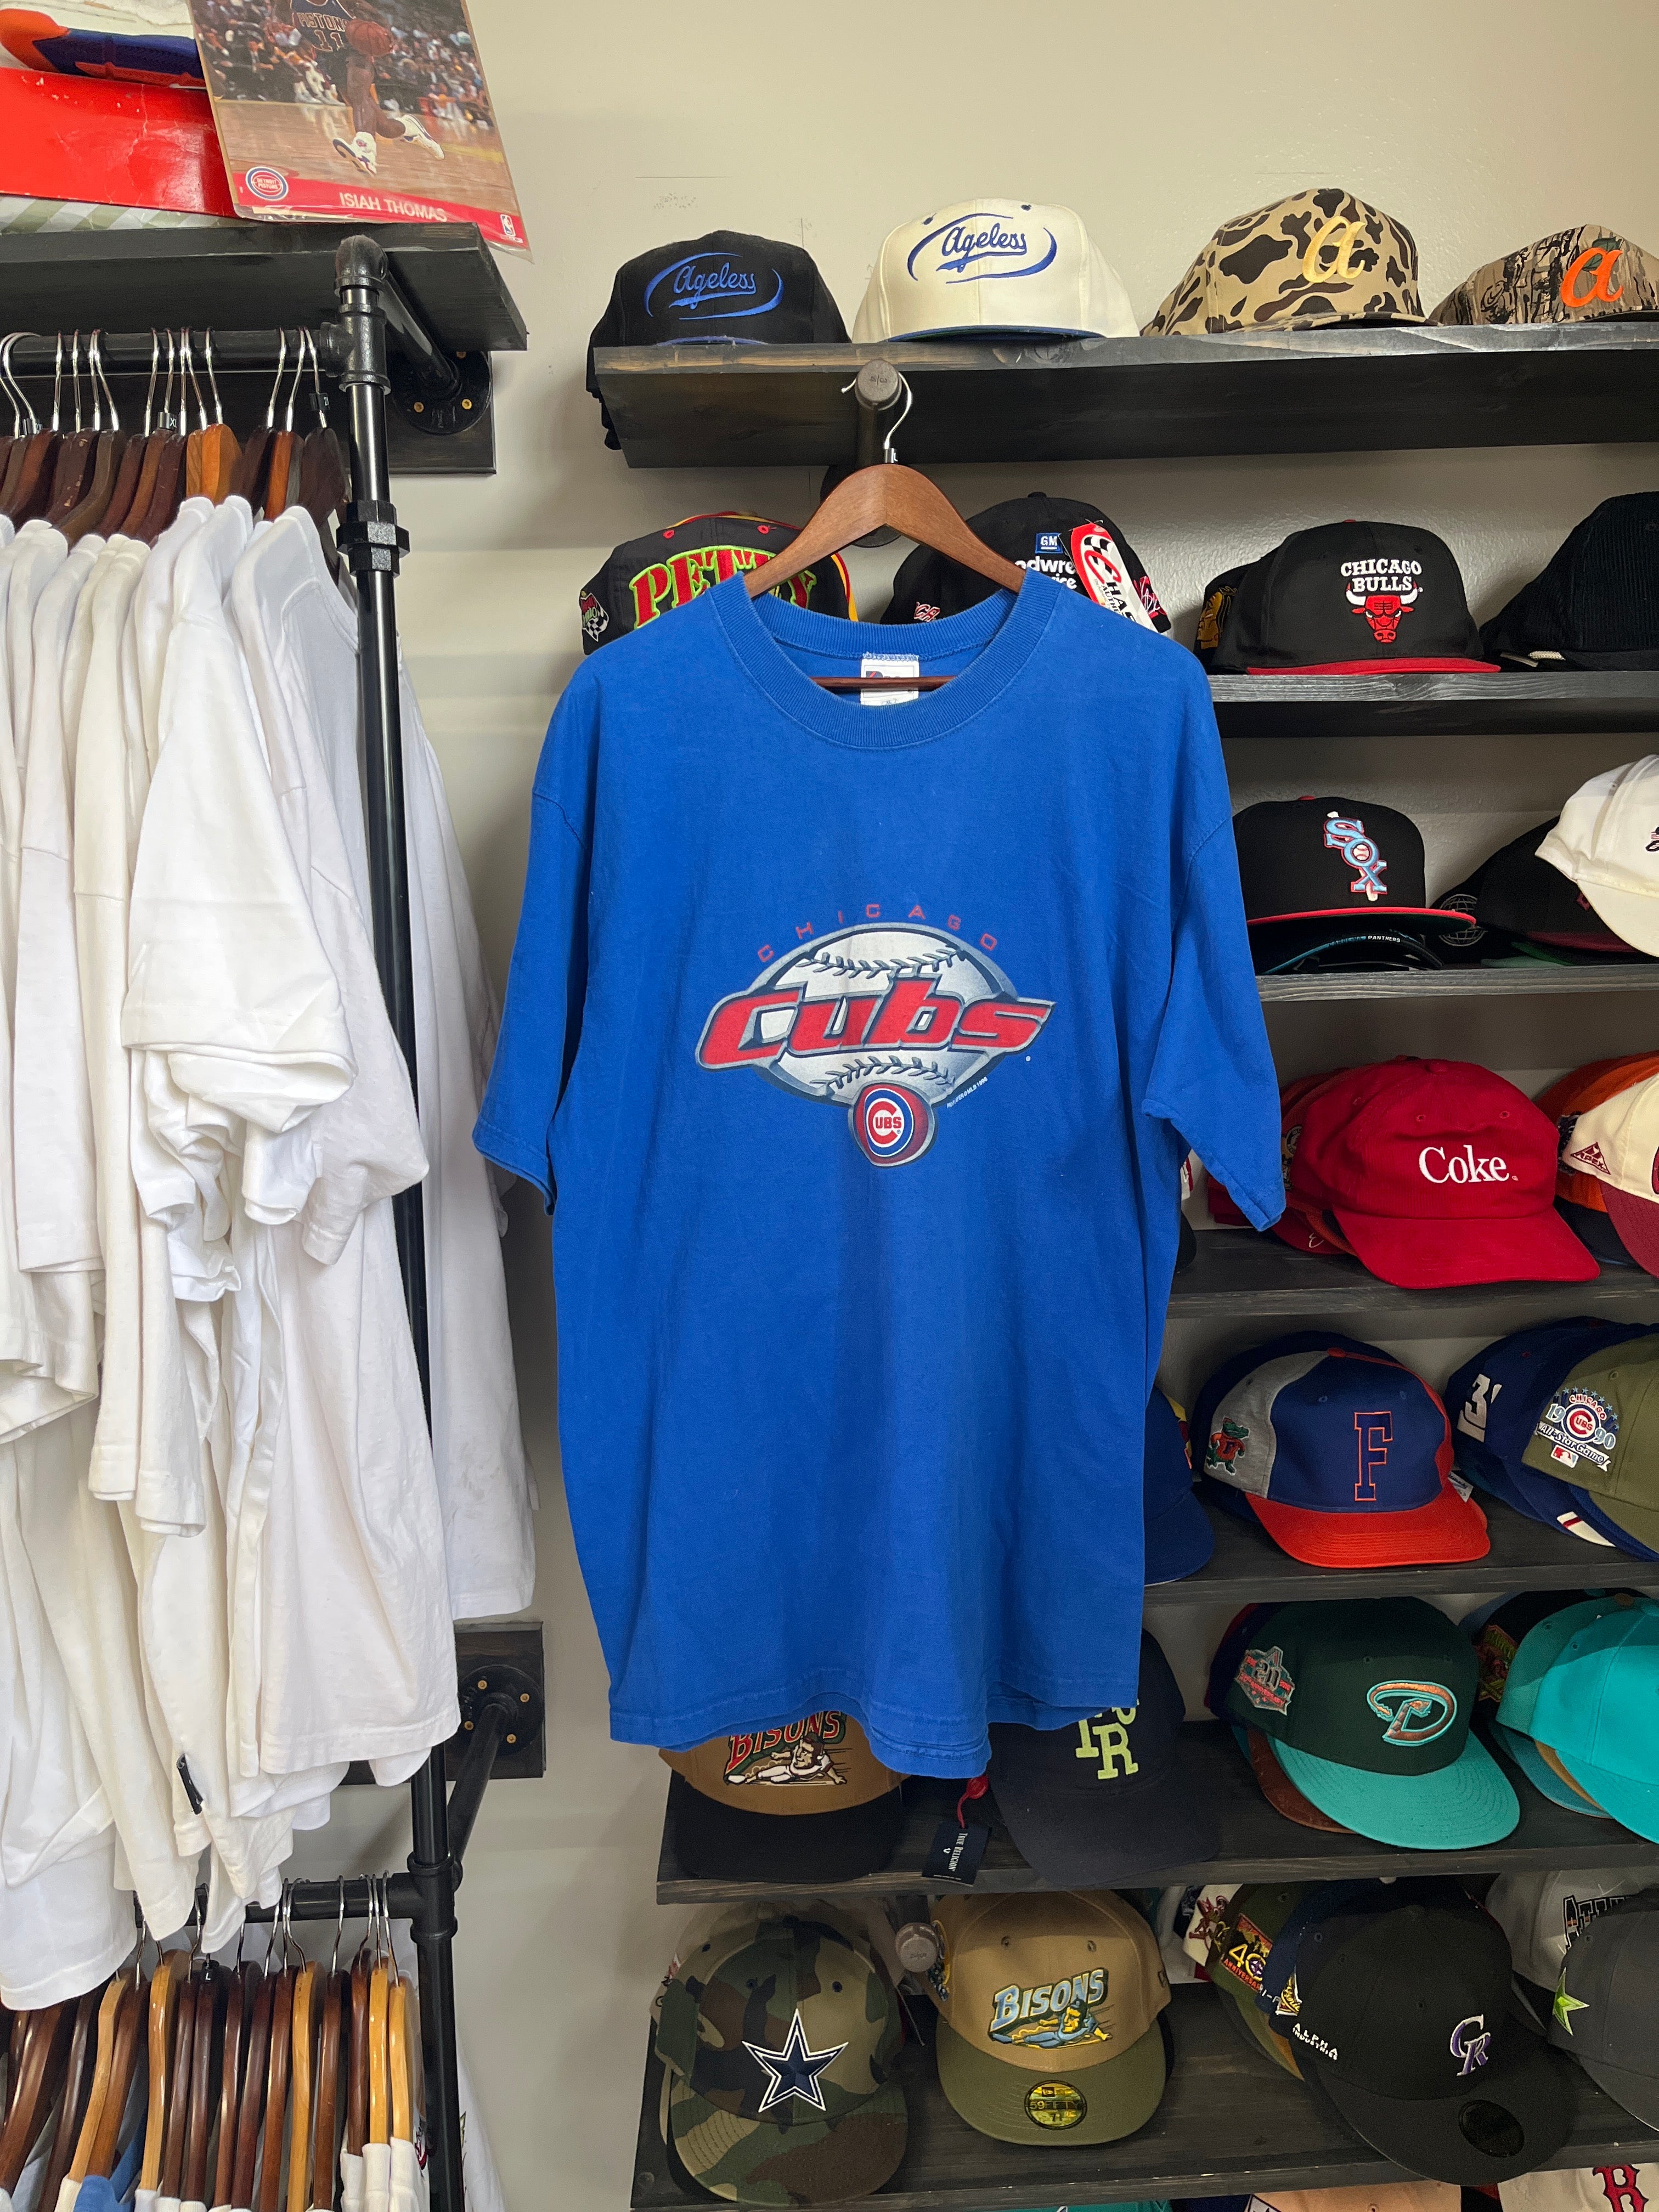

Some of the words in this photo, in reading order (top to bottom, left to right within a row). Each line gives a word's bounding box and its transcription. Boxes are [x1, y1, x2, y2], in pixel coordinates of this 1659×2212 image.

[314, 29, 346, 52] 11
[339, 192, 381, 211] ISIAH
[383, 198, 447, 222] THOMAS
[941, 221, 1027, 271] Ageless
[673, 262, 755, 308] Ageless
[1040, 535, 1058, 546] GM
[1340, 558, 1423, 577] CHICAGO
[1352, 575, 1413, 592] BULLS
[1324, 817, 1387, 895] SOX
[757, 903, 998, 963] CHICAGO
[1367, 935, 1401, 943] PANTHERS
[1419, 1144, 1510, 1184] Coke
[1545, 1403, 1567, 1424] 19
[1569, 1393, 1607, 1421] CHICAGO
[1354, 1411, 1393, 1502] F
[1576, 1443, 1605, 1465] Game
[725, 1711, 842, 1775] BISONS
[955, 1832, 968, 1846] TRUE
[948, 1846, 964, 1871] RELIGION
[205, 1972, 211, 1980] L
[1223, 1959, 1261, 1990] ANNIVERSAR
[990, 1968, 1104, 2033] BISONS
[1294, 2023, 1338, 2057] ALPHA
